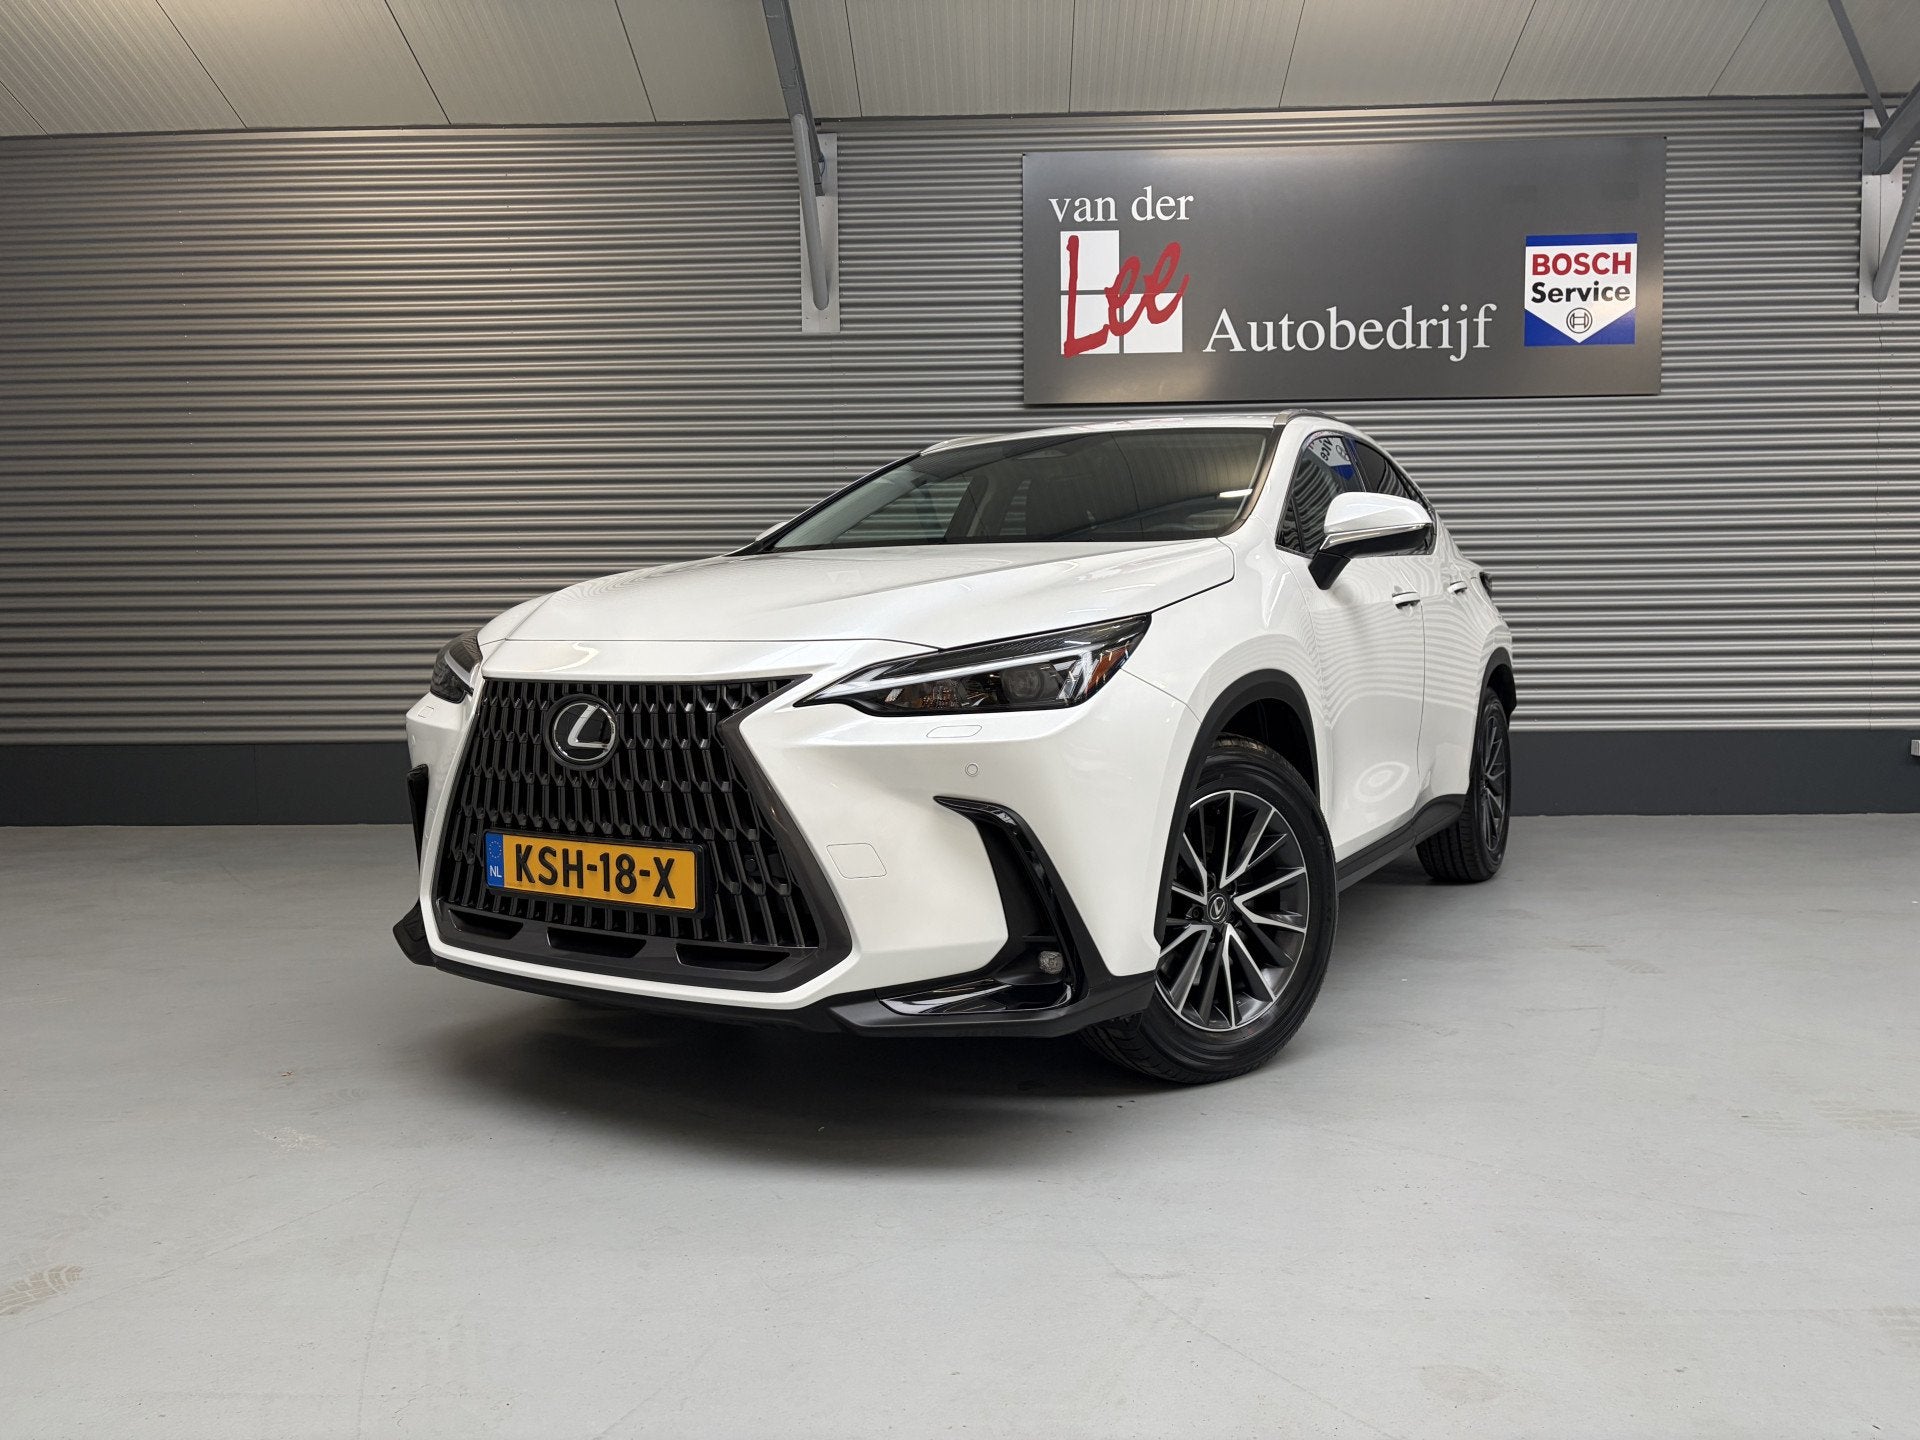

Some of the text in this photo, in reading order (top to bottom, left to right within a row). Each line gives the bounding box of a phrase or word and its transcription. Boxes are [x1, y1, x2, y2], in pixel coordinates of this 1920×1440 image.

[1048, 185, 1194, 223] van der
[1532, 252, 1631, 276] BOSCH
[1064, 235, 1190, 358] Lee
[1531, 280, 1630, 304] Service
[1203, 303, 1497, 362] Autobedrijf
[489, 865, 503, 878] NL
[515, 843, 676, 899] KSH-18-X
